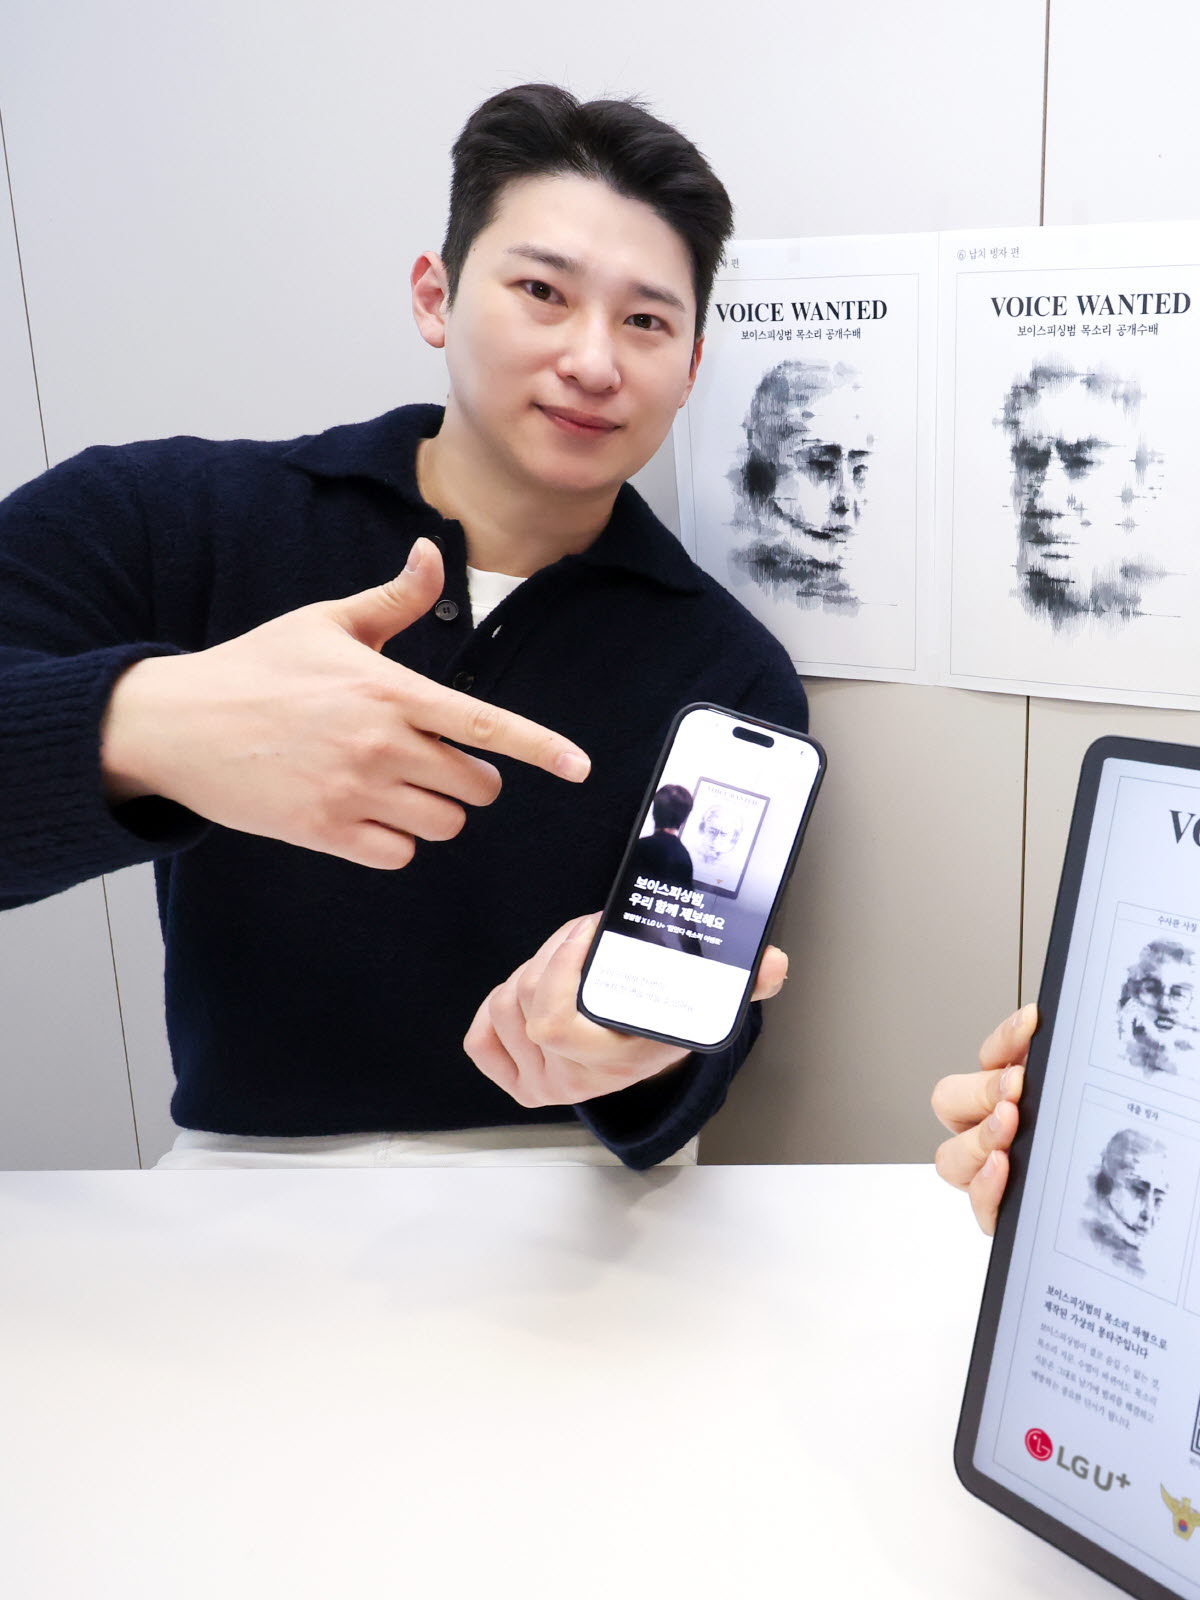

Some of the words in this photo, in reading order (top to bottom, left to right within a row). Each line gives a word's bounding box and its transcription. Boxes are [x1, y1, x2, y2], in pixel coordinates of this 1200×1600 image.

[731, 257, 740, 269] 편
[969, 247, 986, 260] 납치
[990, 247, 1007, 259] 빙자
[1010, 246, 1020, 259] 편
[715, 302, 785, 323] VOICE
[790, 299, 888, 321] WANTED
[990, 295, 1068, 318] VOICE
[1076, 292, 1192, 316] WANTED
[740, 328, 793, 341] 보이스피싱범
[796, 328, 822, 340] 목소리
[825, 327, 862, 340] 공개수배
[1017, 324, 1076, 338] 보이스피싱범
[1081, 323, 1112, 337] 목소리
[1116, 322, 1159, 336] 공개수배
[634, 875, 705, 909] 보이스피싱범,
[628, 892, 654, 910] 우리
[654, 899, 680, 918] 함께
[679, 906, 726, 930] 제보해요
[1045, 1284, 1102, 1319] 보이스피싱범의
[1104, 1311, 1130, 1333] 목소리
[1070, 1312, 1095, 1333] 가상의
[1056, 1445, 1090, 1480] LG
[1093, 1465, 1131, 1492] U+
